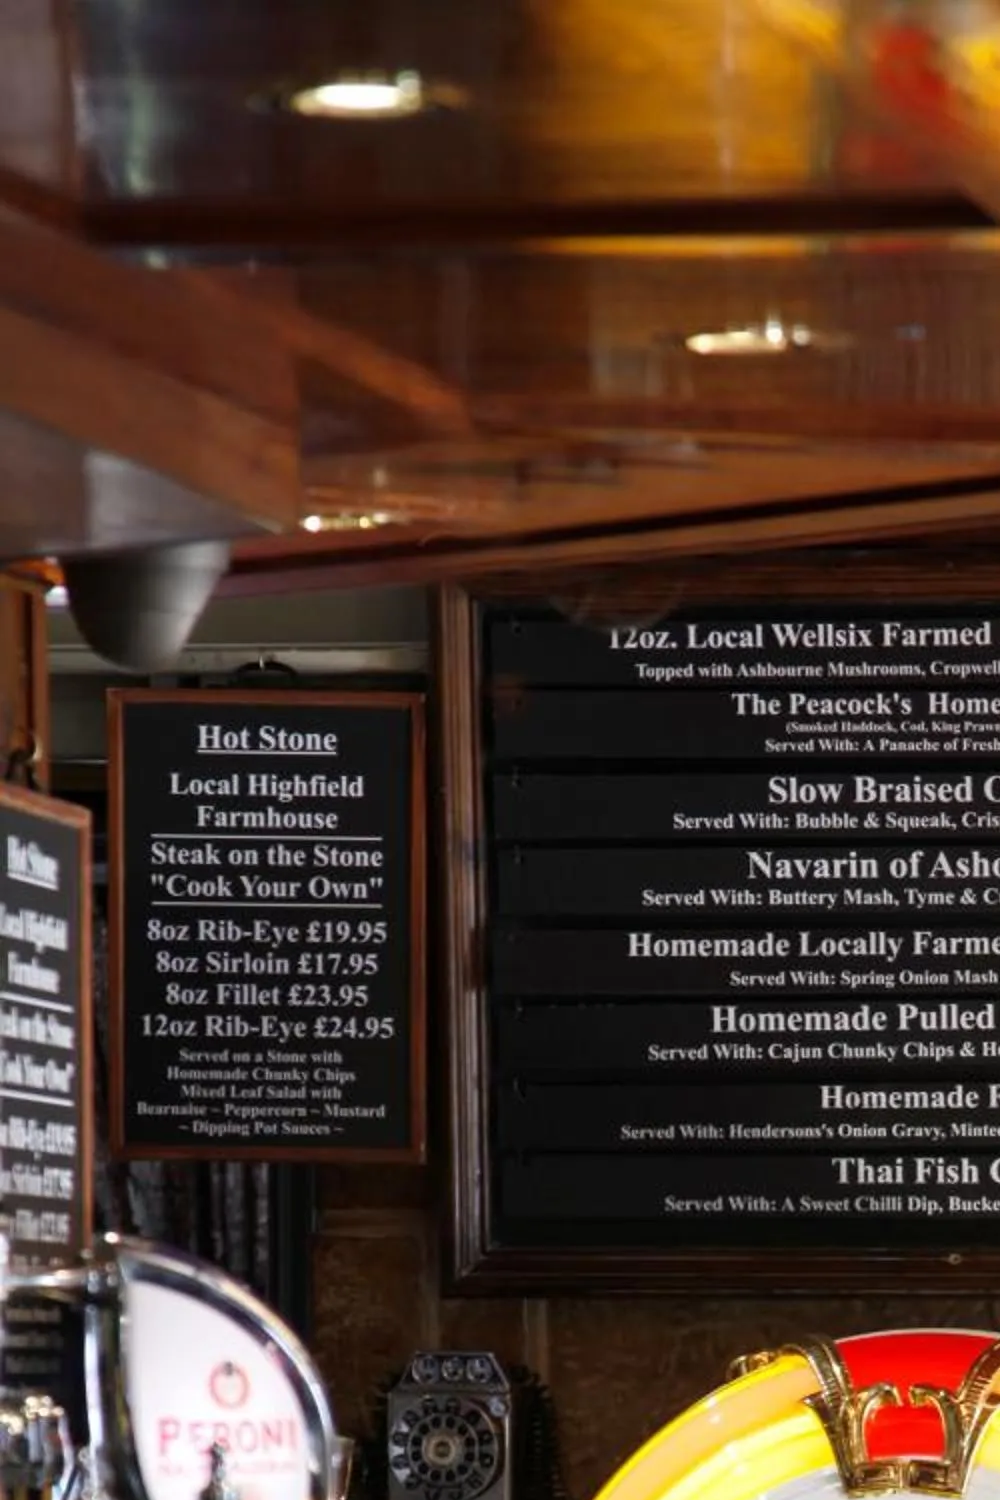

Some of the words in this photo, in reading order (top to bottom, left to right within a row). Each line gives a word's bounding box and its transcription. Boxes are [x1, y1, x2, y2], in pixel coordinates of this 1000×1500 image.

[610, 628, 678, 648] 12oz.
[687, 624, 764, 648] Local
[771, 624, 873, 647] Wellsix
[882, 621, 992, 646] Farmed
[635, 664, 694, 681] Topped
[697, 664, 734, 677] with
[736, 663, 824, 677] Ashbourne
[827, 662, 927, 676] Mushrooms,
[731, 693, 781, 715] The
[789, 693, 913, 715] Peacock's
[198, 725, 251, 750] Hot
[258, 726, 338, 751] Stone
[170, 773, 240, 795] Local
[248, 774, 364, 802] Highfield
[768, 776, 843, 803] Slow
[854, 776, 974, 802] Braised
[197, 806, 339, 829] Farmhouse
[673, 814, 734, 829] Served
[738, 813, 790, 828] With:
[795, 813, 859, 828] Bubble
[863, 812, 881, 828] &
[885, 812, 958, 832] Squeak,
[151, 842, 222, 864] Steak
[227, 850, 259, 865] on
[267, 844, 307, 866] the
[313, 845, 384, 867] Stone
[747, 852, 879, 878] Navarin
[889, 851, 925, 878] of
[151, 874, 233, 896] "Cook
[239, 876, 302, 897] Your
[307, 876, 384, 898] Own"
[642, 890, 705, 905] Served
[709, 889, 763, 905] With:
[768, 890, 838, 909] Buttery
[843, 888, 900, 906] Mash,
[903, 889, 956, 908] Tyme
[959, 888, 977, 904] &
[146, 919, 190, 940] 8oz
[197, 920, 300, 947] Rib-Eye
[306, 921, 387, 943] £19.95
[628, 933, 791, 956] Homemade
[799, 932, 903, 961] Locally
[156, 951, 199, 972] 8oz
[205, 952, 290, 974] Sirloin
[297, 953, 379, 975] £17.95
[729, 972, 786, 985] Served
[789, 971, 836, 985] With:
[839, 971, 896, 988] Spring
[898, 970, 950, 984] Onion
[953, 970, 999, 984] Mash
[165, 983, 209, 1004] 8oz
[216, 984, 281, 1005] Fillet
[287, 984, 369, 1007] £23.95
[142, 1014, 197, 1036] 12oz
[205, 1016, 307, 1042] Rib-Eye
[313, 1016, 395, 1039] £24.95
[712, 1005, 888, 1032] Homemade
[897, 1004, 996, 1030] Pulled
[648, 1044, 709, 1060] Served
[713, 1044, 763, 1059] With:
[767, 1044, 823, 1062] Cajun
[827, 1043, 897, 1062] Chunky
[902, 1042, 955, 1061] Chips
[959, 1042, 976, 1057] &
[820, 1085, 980, 1109] Homemade
[621, 1126, 675, 1138] Served
[679, 1126, 724, 1138] With:
[837, 1124, 888, 1137] Onion
[891, 1124, 947, 1140] Gravy,
[831, 1158, 904, 1183] Thai
[915, 1158, 980, 1184] Fish
[664, 1197, 724, 1211] Served
[728, 1197, 777, 1211] With:
[782, 1198, 796, 1211] A
[800, 1198, 851, 1212] Sweet
[854, 1197, 903, 1211] Chilli
[906, 1196, 945, 1215] Dip,
[156, 1418, 298, 1456] PERONI
